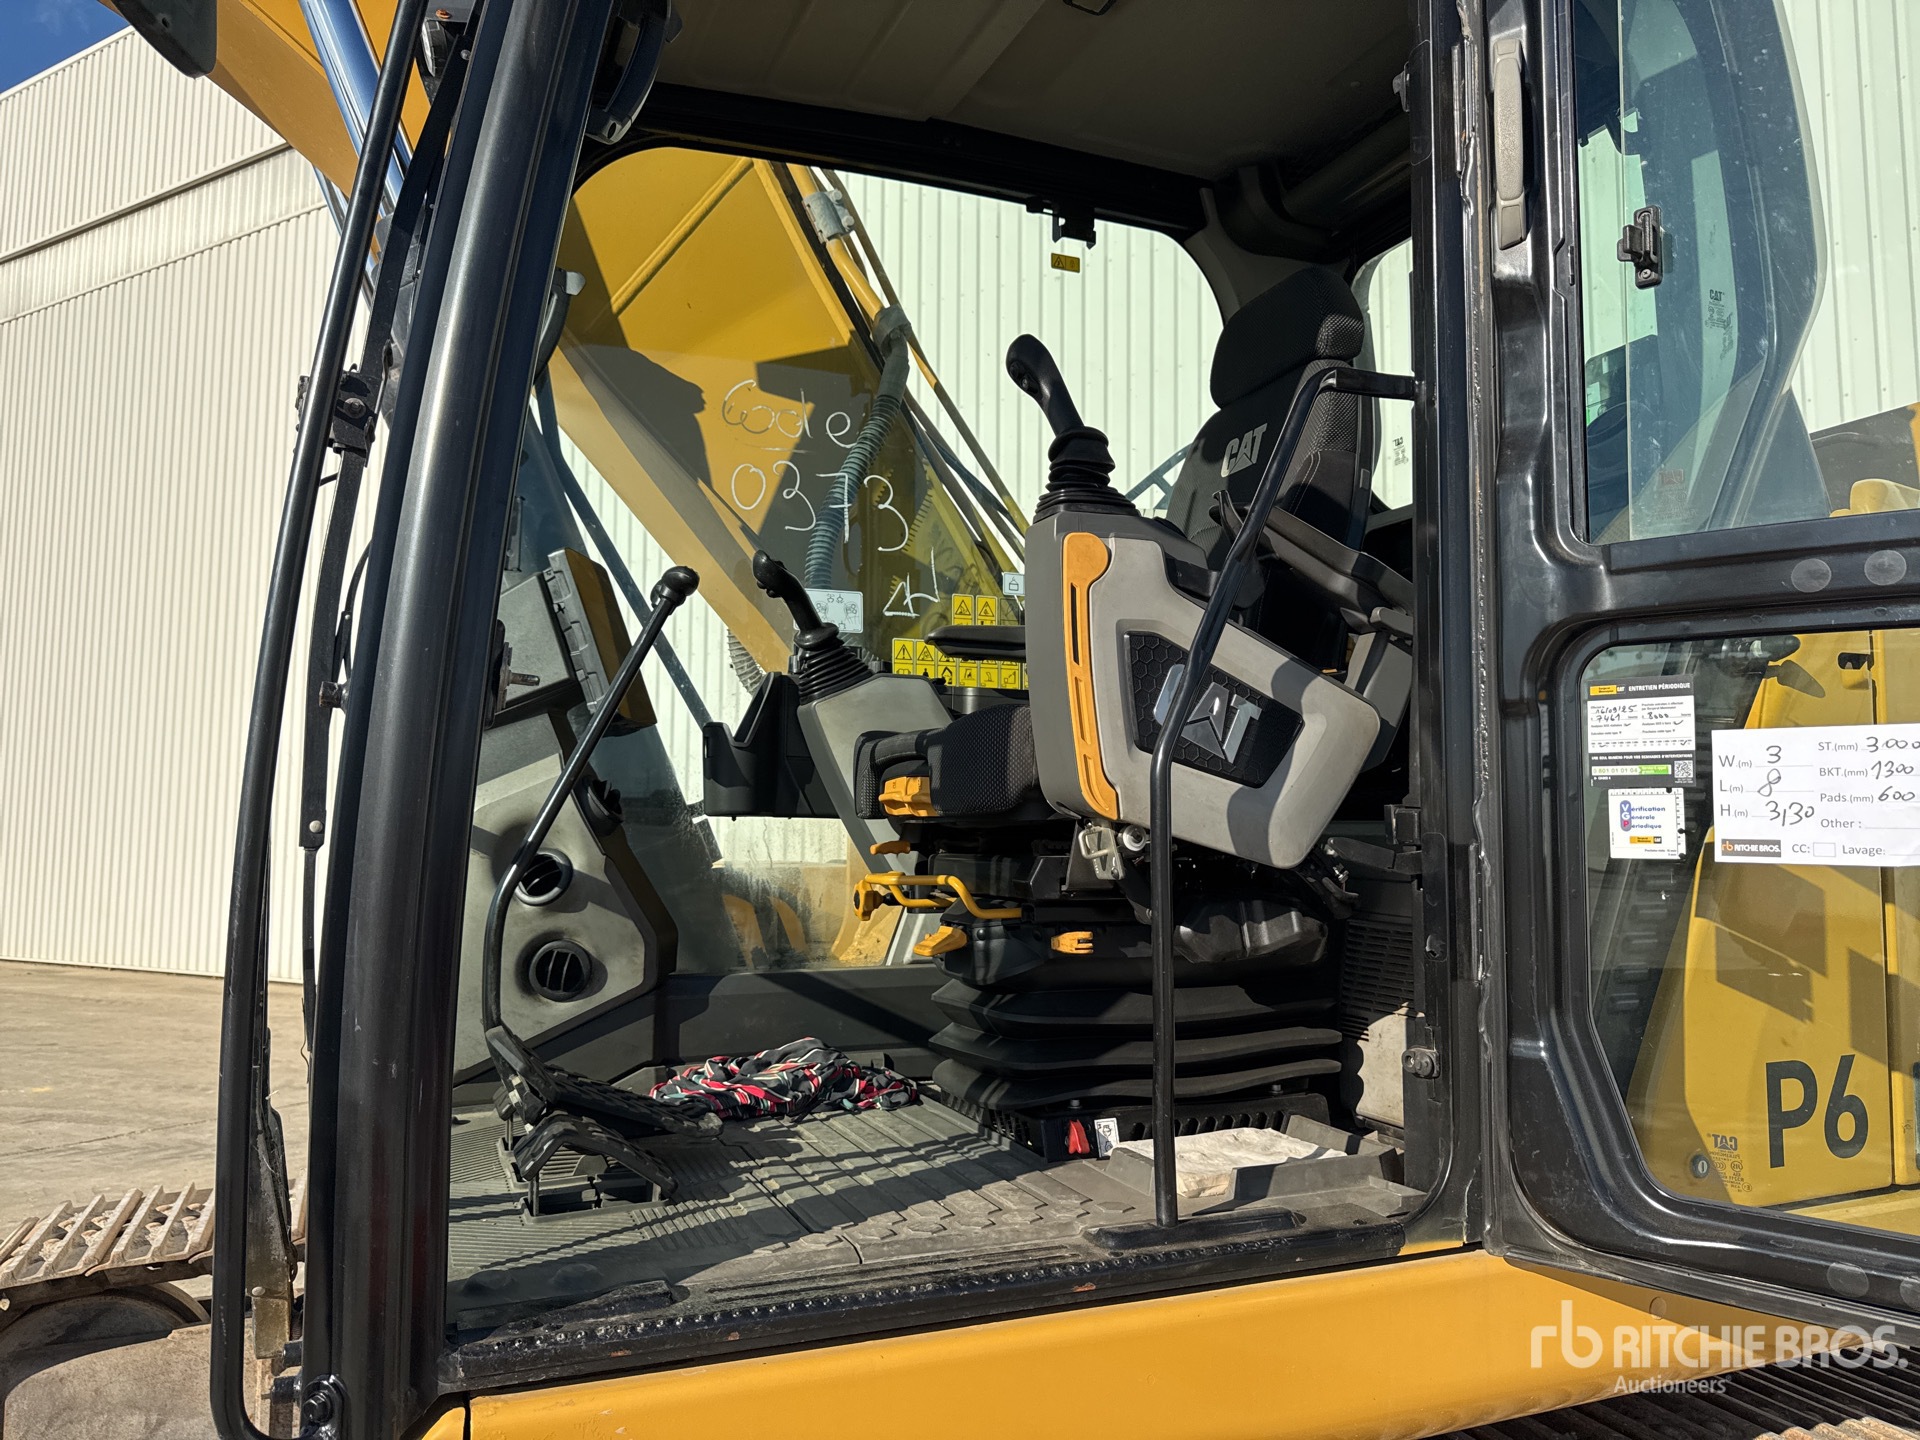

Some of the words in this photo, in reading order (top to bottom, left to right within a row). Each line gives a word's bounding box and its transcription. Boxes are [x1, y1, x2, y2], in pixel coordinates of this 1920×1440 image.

[1710, 289, 1722, 301] CAT
[1220, 422, 1268, 478] CAT
[731, 460, 909, 552] 0373
[1628, 684, 1658, 692] ENTRETIEN
[1658, 682, 1691, 690] PÉRIODIQUE
[1766, 745, 1782, 764] 3
[1870, 760, 1914, 780] 1300
[1757, 768, 1782, 797] 8
[1878, 786, 1916, 802] 600
[1820, 818, 1855, 828] Other
[1722, 841, 1734, 851] rb
[1734, 844, 1759, 852] RITCHIE
[1759, 844, 1781, 852] BROS.
[1792, 844, 1810, 854] CC:
[1842, 845, 1886, 857] Lavage:
[1765, 1053, 1869, 1169] P6
